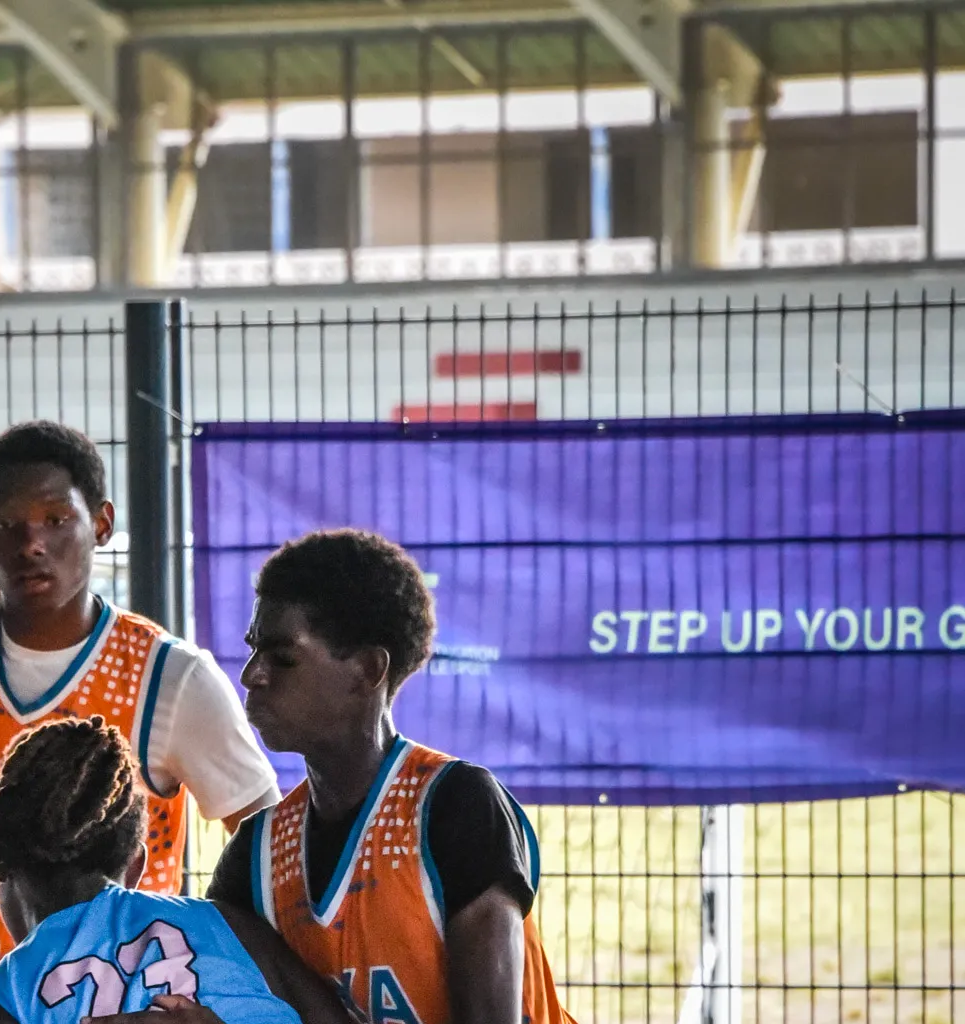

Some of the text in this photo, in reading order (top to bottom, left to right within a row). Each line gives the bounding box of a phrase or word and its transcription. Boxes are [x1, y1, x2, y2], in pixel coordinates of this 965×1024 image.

[589, 609, 708, 653] STEP
[721, 608, 783, 652] UP
[795, 606, 925, 651] YOUR
